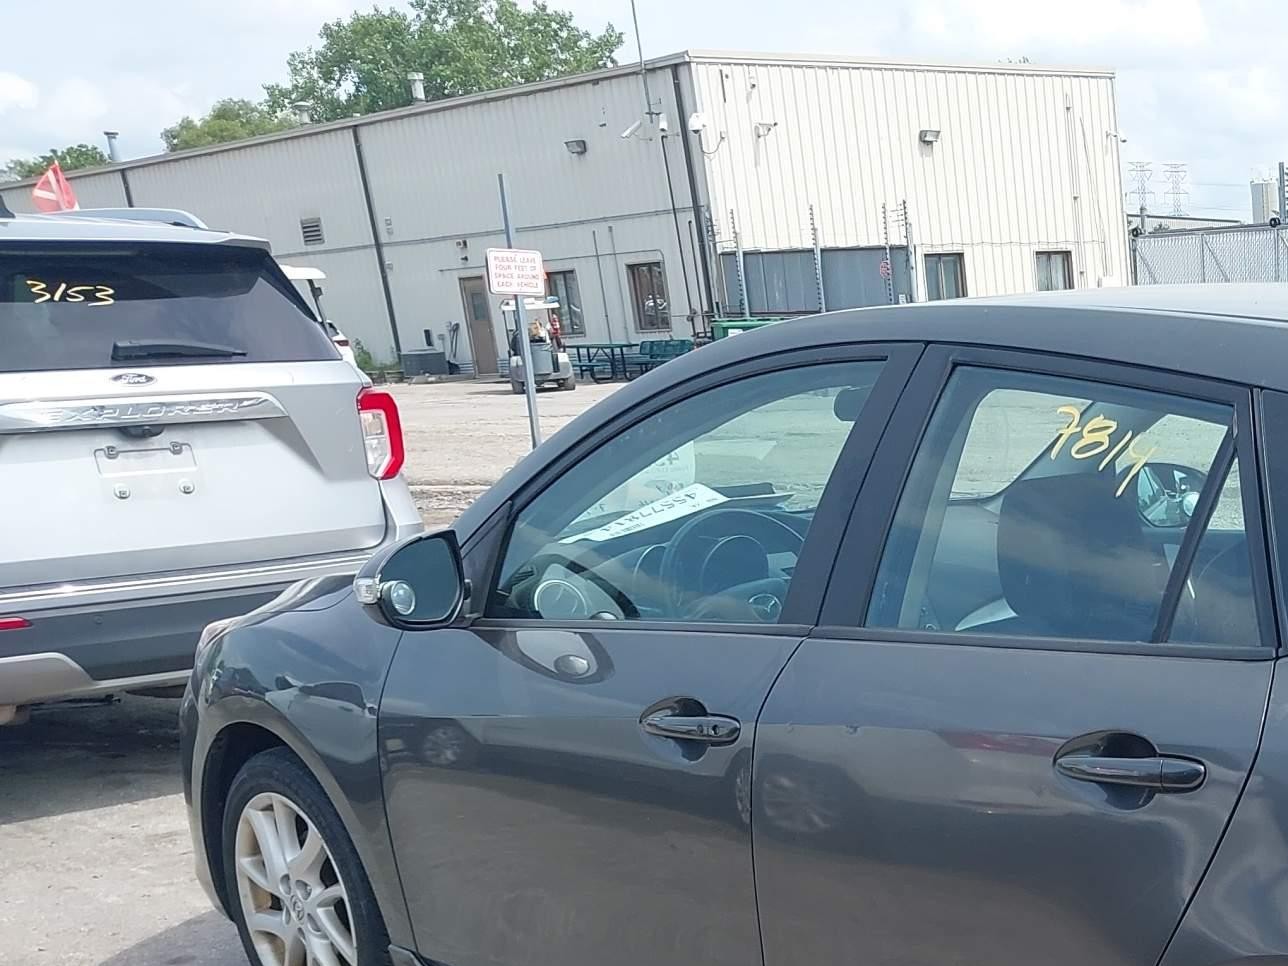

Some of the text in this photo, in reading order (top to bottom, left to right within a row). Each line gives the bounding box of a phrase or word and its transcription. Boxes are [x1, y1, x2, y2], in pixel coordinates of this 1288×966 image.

[495, 263, 512, 271] FOUR
[514, 264, 528, 272] FEET
[25, 279, 116, 307] 3153
[46, 400, 240, 423] EXPLORER
[1050, 403, 1157, 498] 7814
